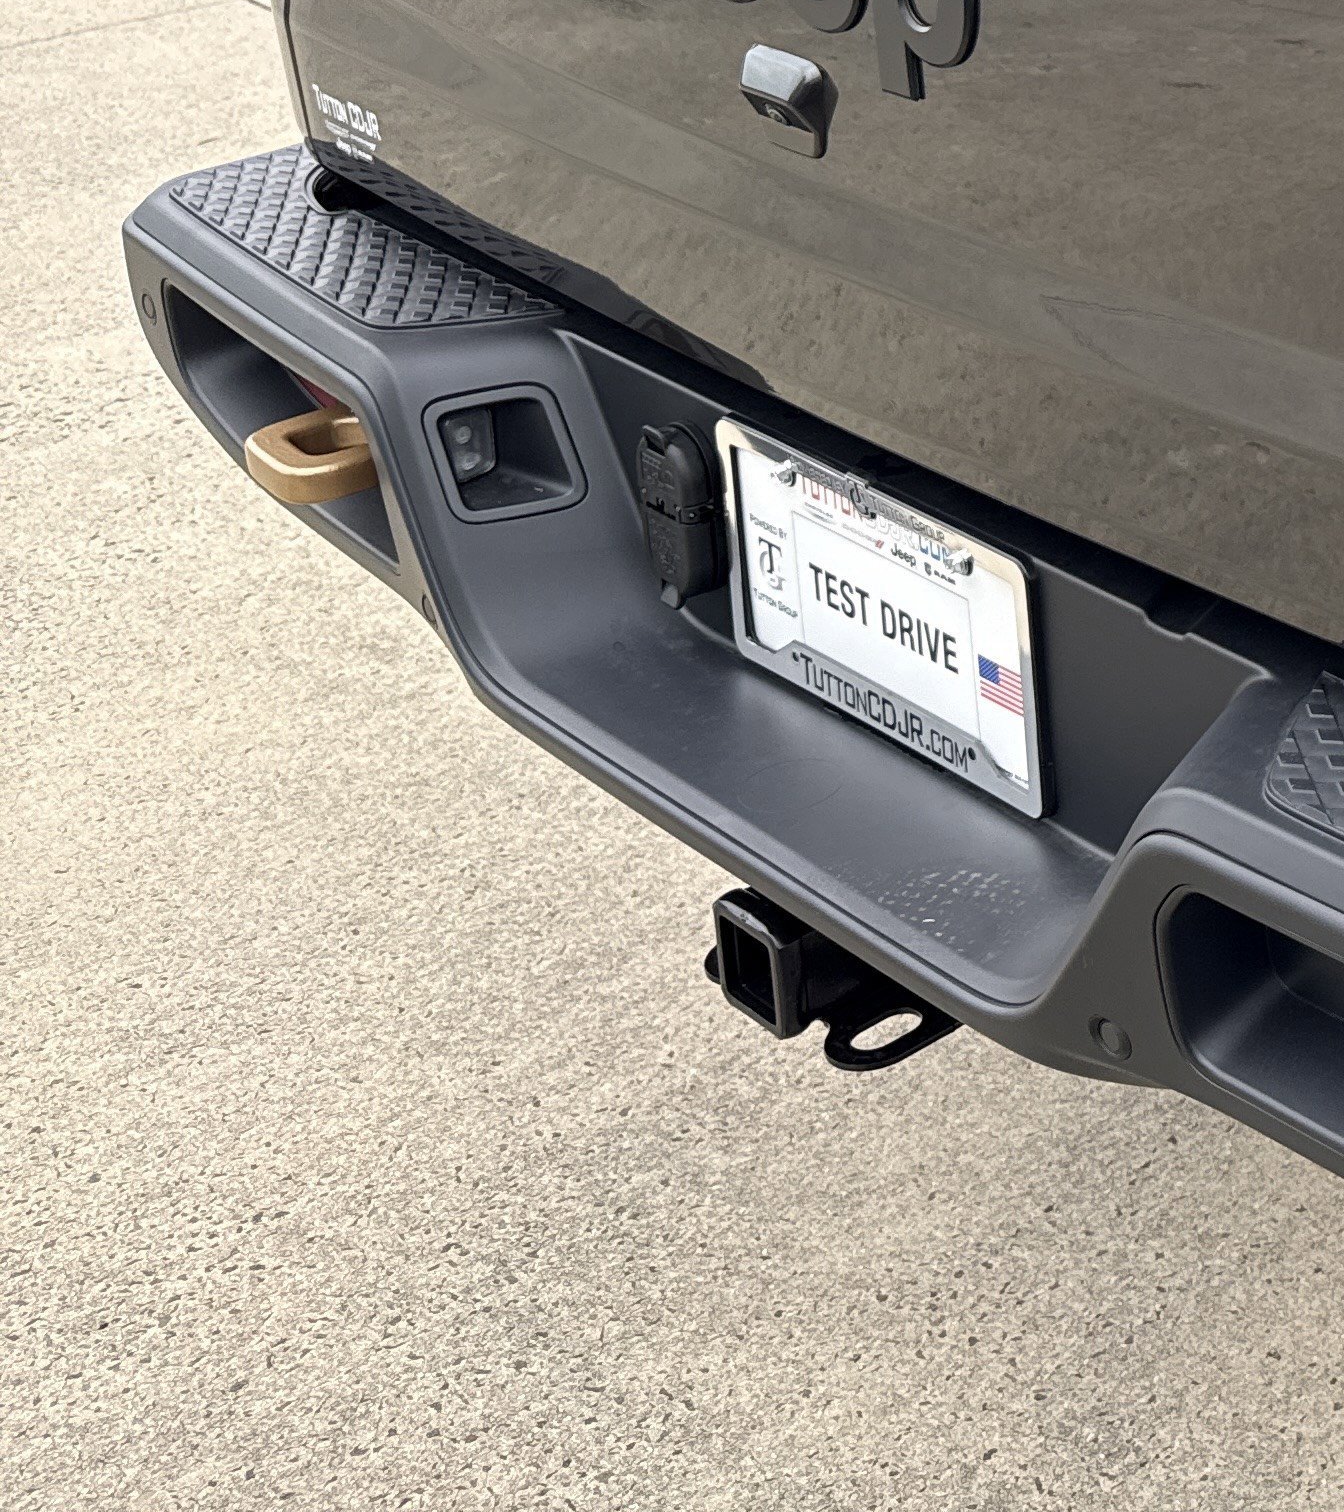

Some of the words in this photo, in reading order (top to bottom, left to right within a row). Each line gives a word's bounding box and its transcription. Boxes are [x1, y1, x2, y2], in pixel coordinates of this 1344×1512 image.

[890, 542, 917, 568] Jeep
[808, 561, 870, 627] TEST
[880, 598, 959, 675] DRIVE
